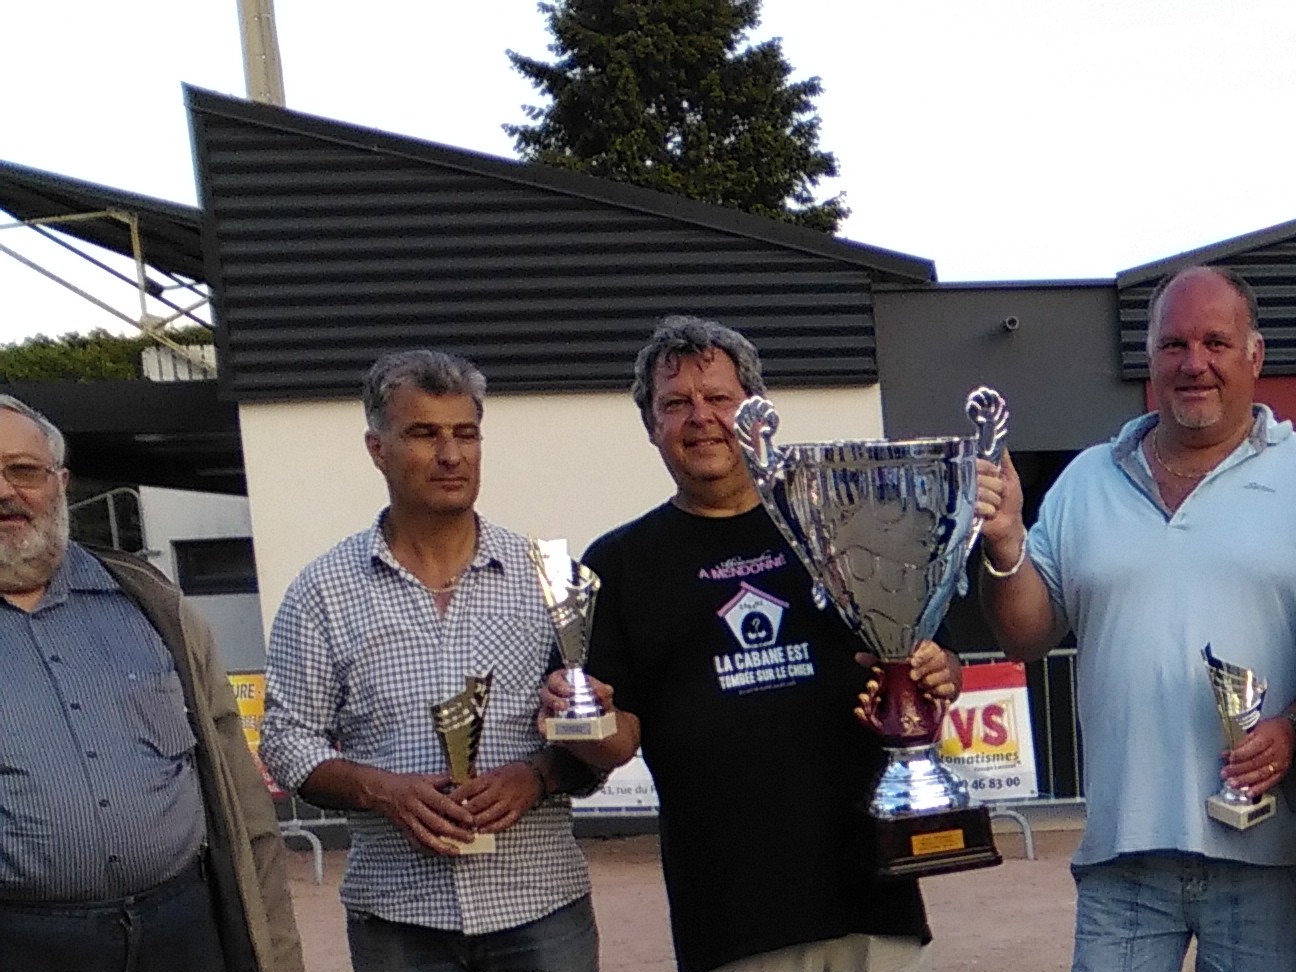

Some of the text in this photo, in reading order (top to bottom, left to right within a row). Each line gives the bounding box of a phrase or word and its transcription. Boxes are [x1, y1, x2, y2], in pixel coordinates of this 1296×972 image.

[714, 642, 810, 673] LA CABANE EST
[756, 668, 776, 682] SUR
[775, 665, 787, 680] LE
[787, 662, 815, 678] CHIEN
[939, 752, 1019, 765] tomatismes
[616, 786, 633, 795] rue
[634, 783, 648, 795] du
[988, 777, 1003, 790] 83
[1006, 776, 1021, 788] 00
